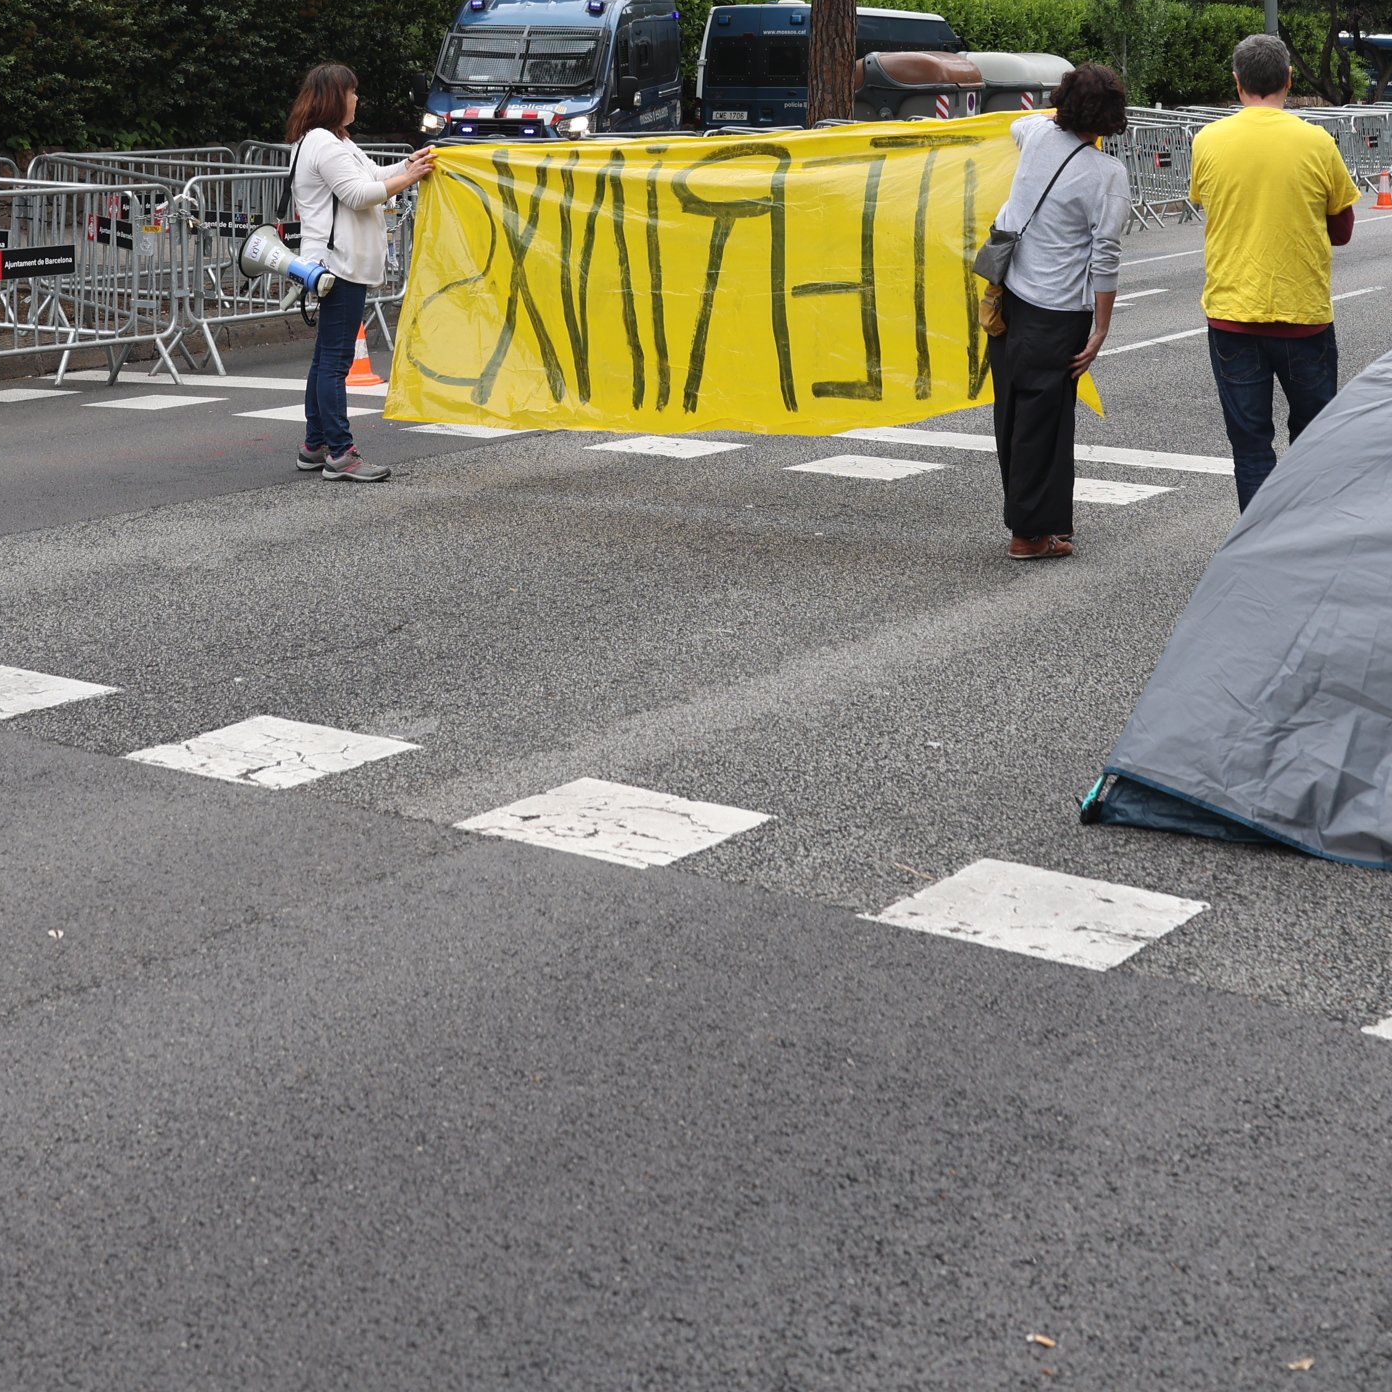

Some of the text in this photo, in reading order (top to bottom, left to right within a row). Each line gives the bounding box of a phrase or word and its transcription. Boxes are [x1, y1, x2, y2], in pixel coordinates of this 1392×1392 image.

[511, 103, 555, 112] policia
[4, 260, 37, 269] Ajuntament
[44, 256, 73, 265] Barcelona
